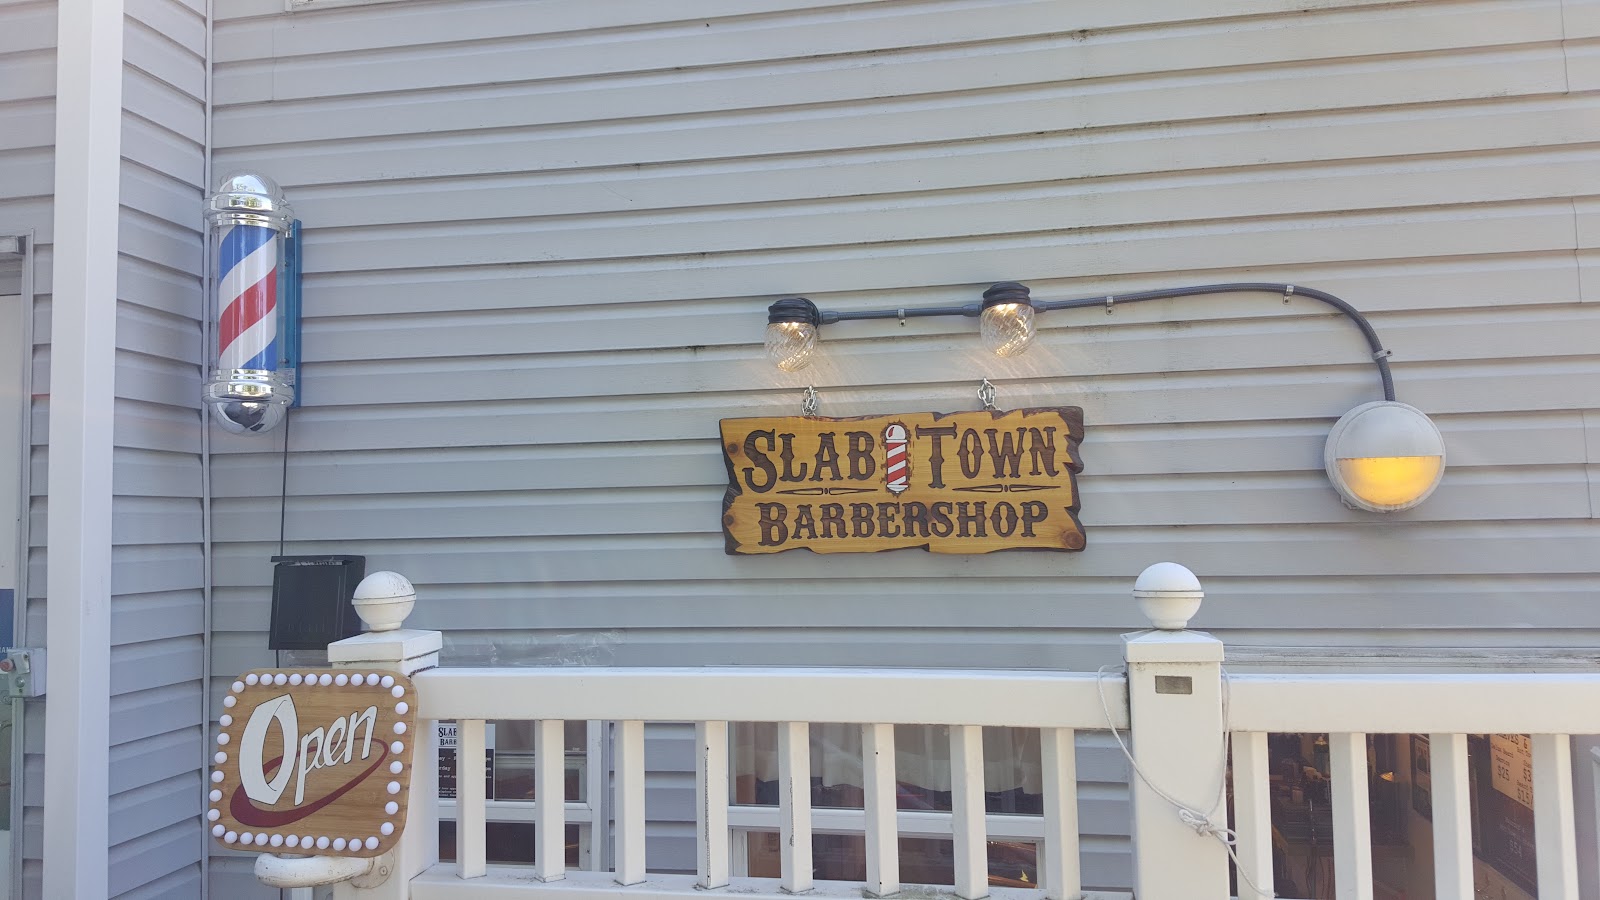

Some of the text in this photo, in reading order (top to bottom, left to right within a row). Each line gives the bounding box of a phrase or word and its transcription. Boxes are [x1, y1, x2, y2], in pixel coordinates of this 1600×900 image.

[742, 421, 1060, 494] SLAB TOWN
[754, 501, 1049, 547] BARBERSHOP
[238, 693, 378, 806] Open
